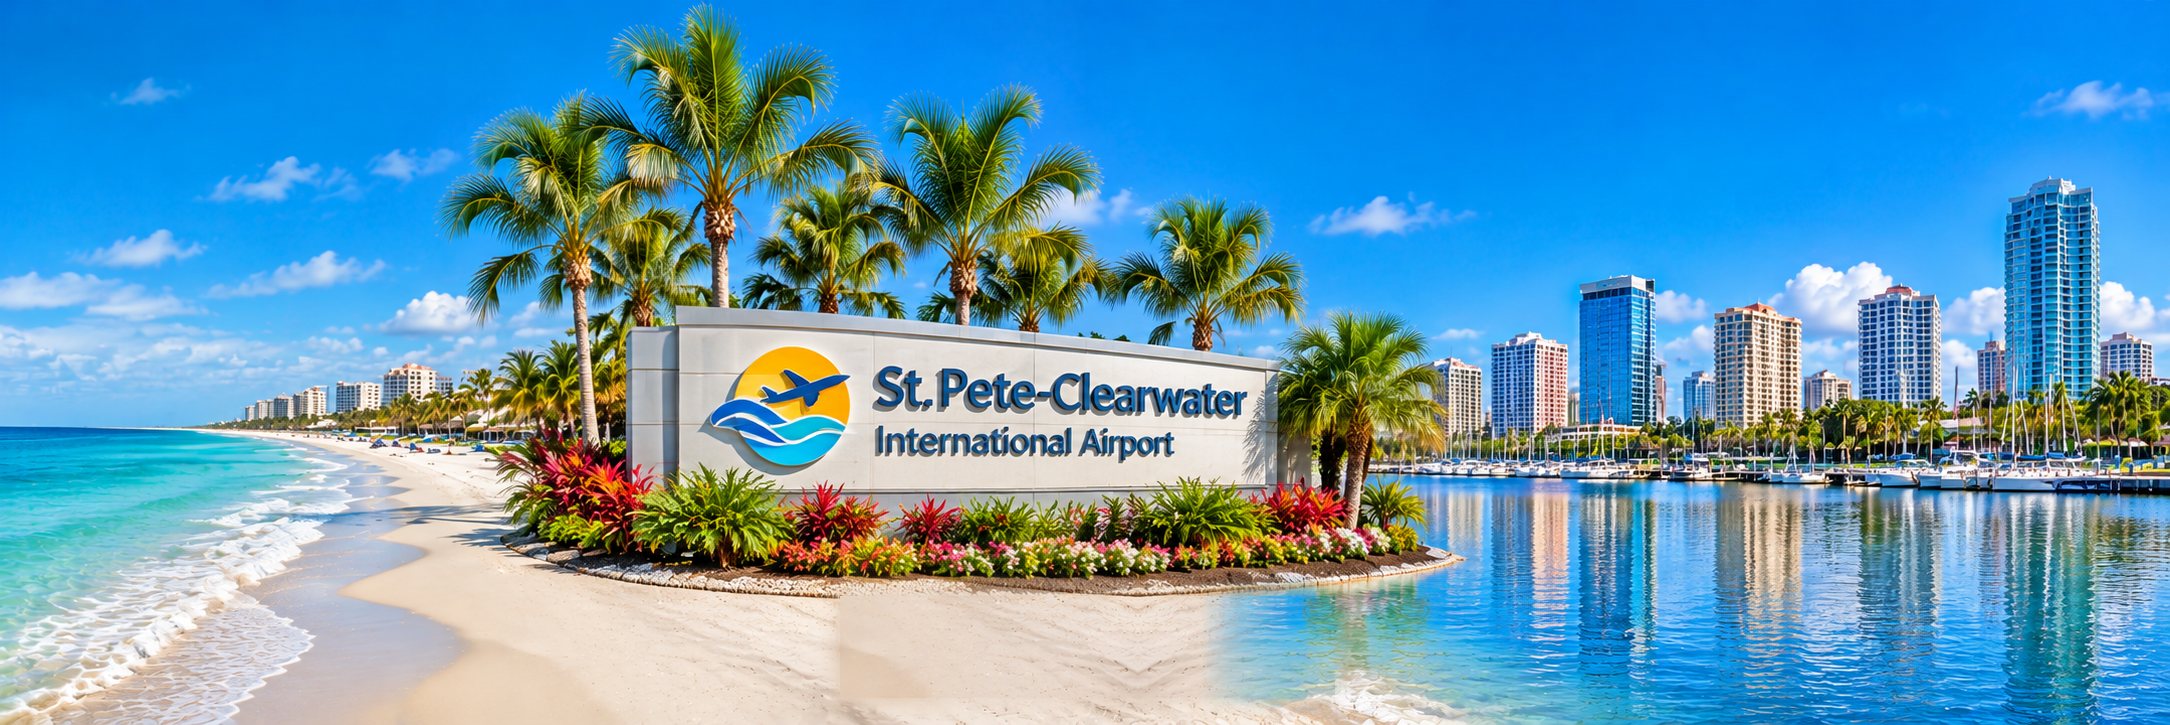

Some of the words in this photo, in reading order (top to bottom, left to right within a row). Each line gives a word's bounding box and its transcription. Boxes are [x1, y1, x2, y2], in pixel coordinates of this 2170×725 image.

[874, 365, 933, 410] St.
[940, 368, 1248, 417] Pete-Clearwater
[874, 425, 1072, 458] International
[1079, 427, 1175, 462] Airport
